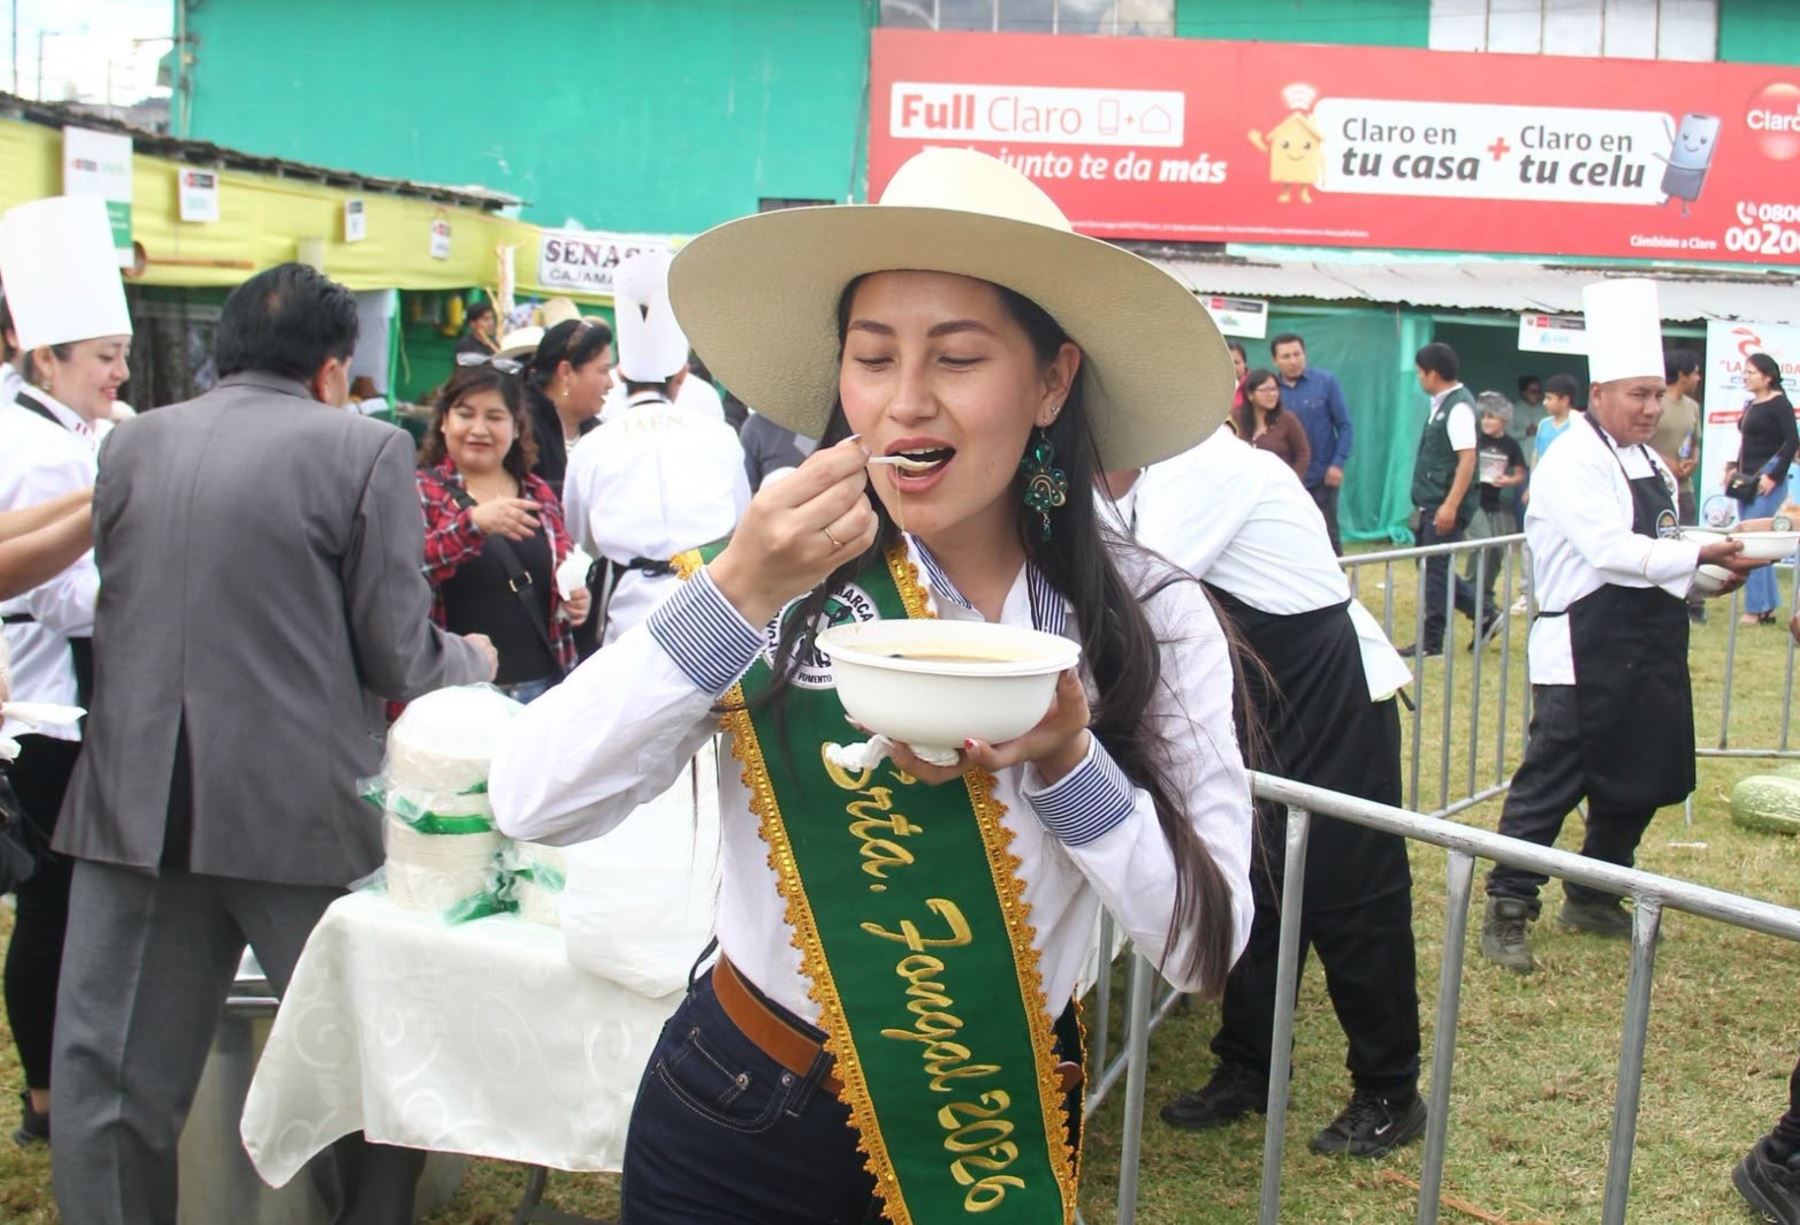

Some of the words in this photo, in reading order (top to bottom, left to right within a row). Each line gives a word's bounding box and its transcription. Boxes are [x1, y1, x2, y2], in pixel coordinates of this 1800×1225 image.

[902, 94, 975, 130] Full
[988, 96, 1082, 135] Claro
[1342, 117, 1415, 144] Claro
[1423, 126, 1457, 145] en
[1520, 125, 1592, 151] Claro
[1600, 134, 1633, 153] en
[1079, 152, 1109, 180] te
[1113, 151, 1153, 181] da
[1158, 152, 1228, 184] más
[1342, 147, 1382, 177] tu
[1392, 154, 1480, 182] casa
[1519, 154, 1559, 184] tu
[1569, 154, 1646, 188] celu
[545, 239, 642, 269] SENA
[1724, 222, 1800, 255] 0020
[937, 1089, 1026, 1214] 2026
